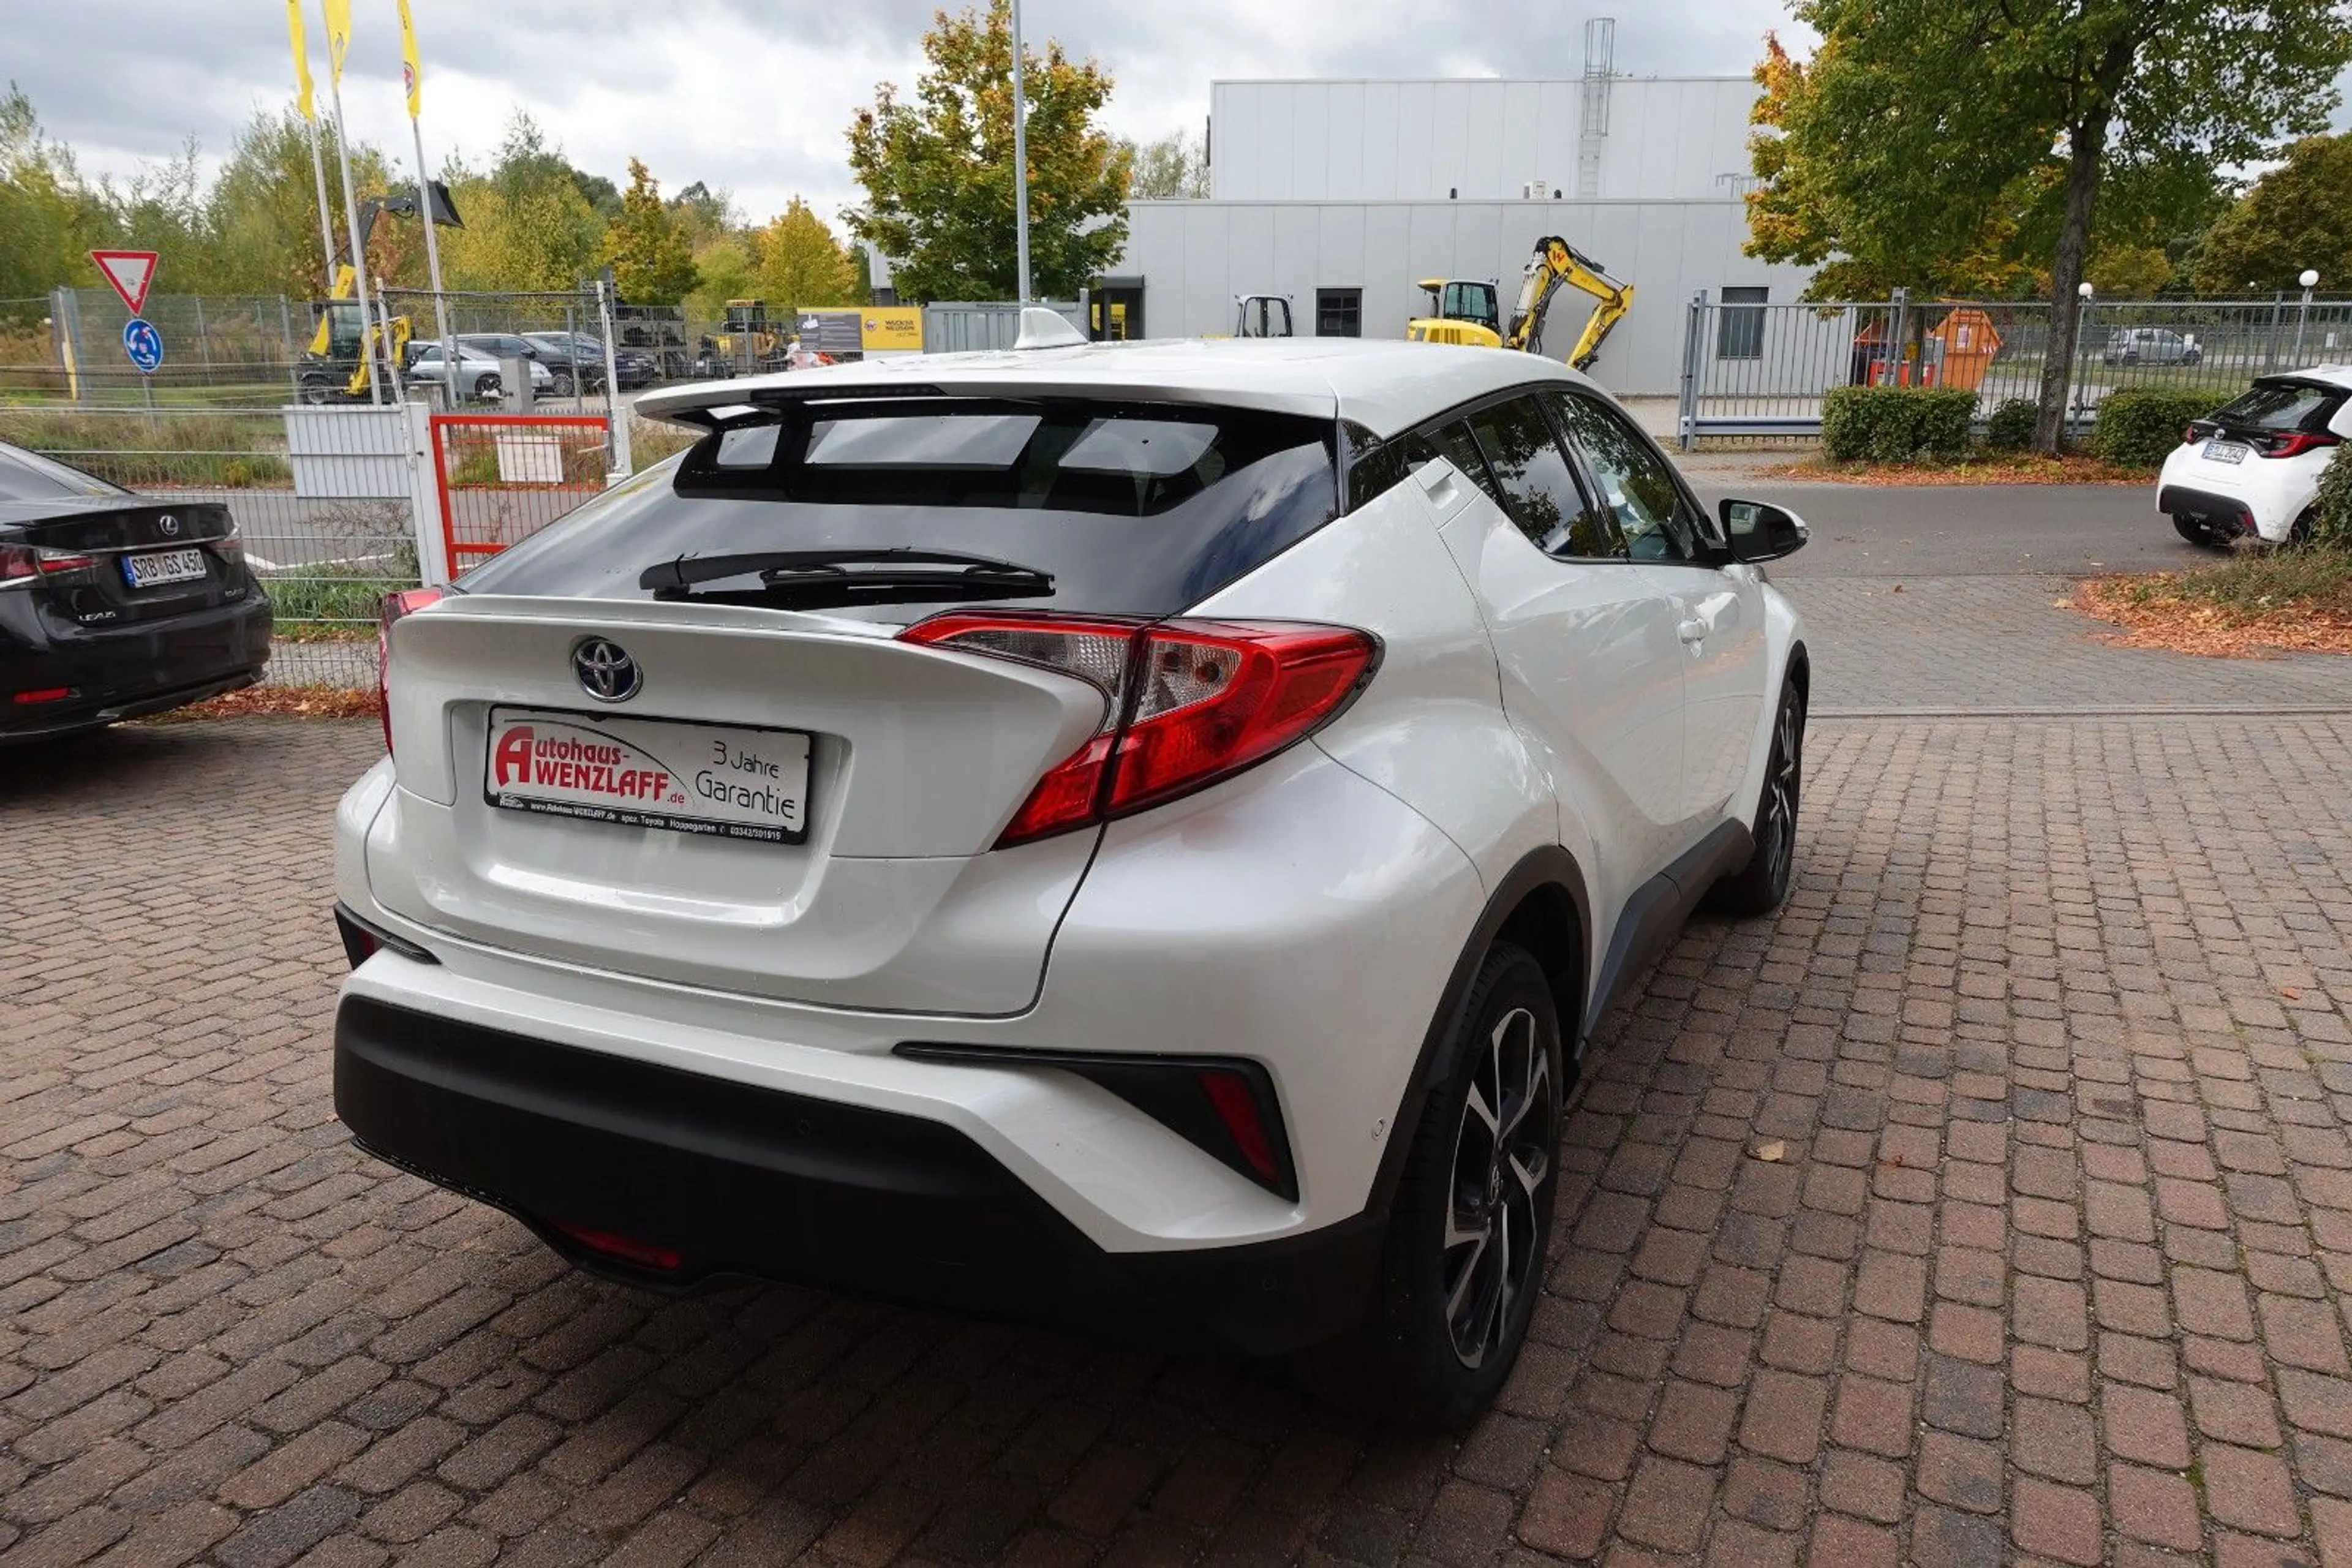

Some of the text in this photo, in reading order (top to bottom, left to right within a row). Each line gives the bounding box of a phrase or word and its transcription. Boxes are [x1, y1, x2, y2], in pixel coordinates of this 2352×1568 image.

[132, 552, 203, 579] SRB GS 450
[714, 741, 779, 778] 3 Jahre
[695, 770, 795, 820] Garantie
[641, 815, 664, 827] Toyota
